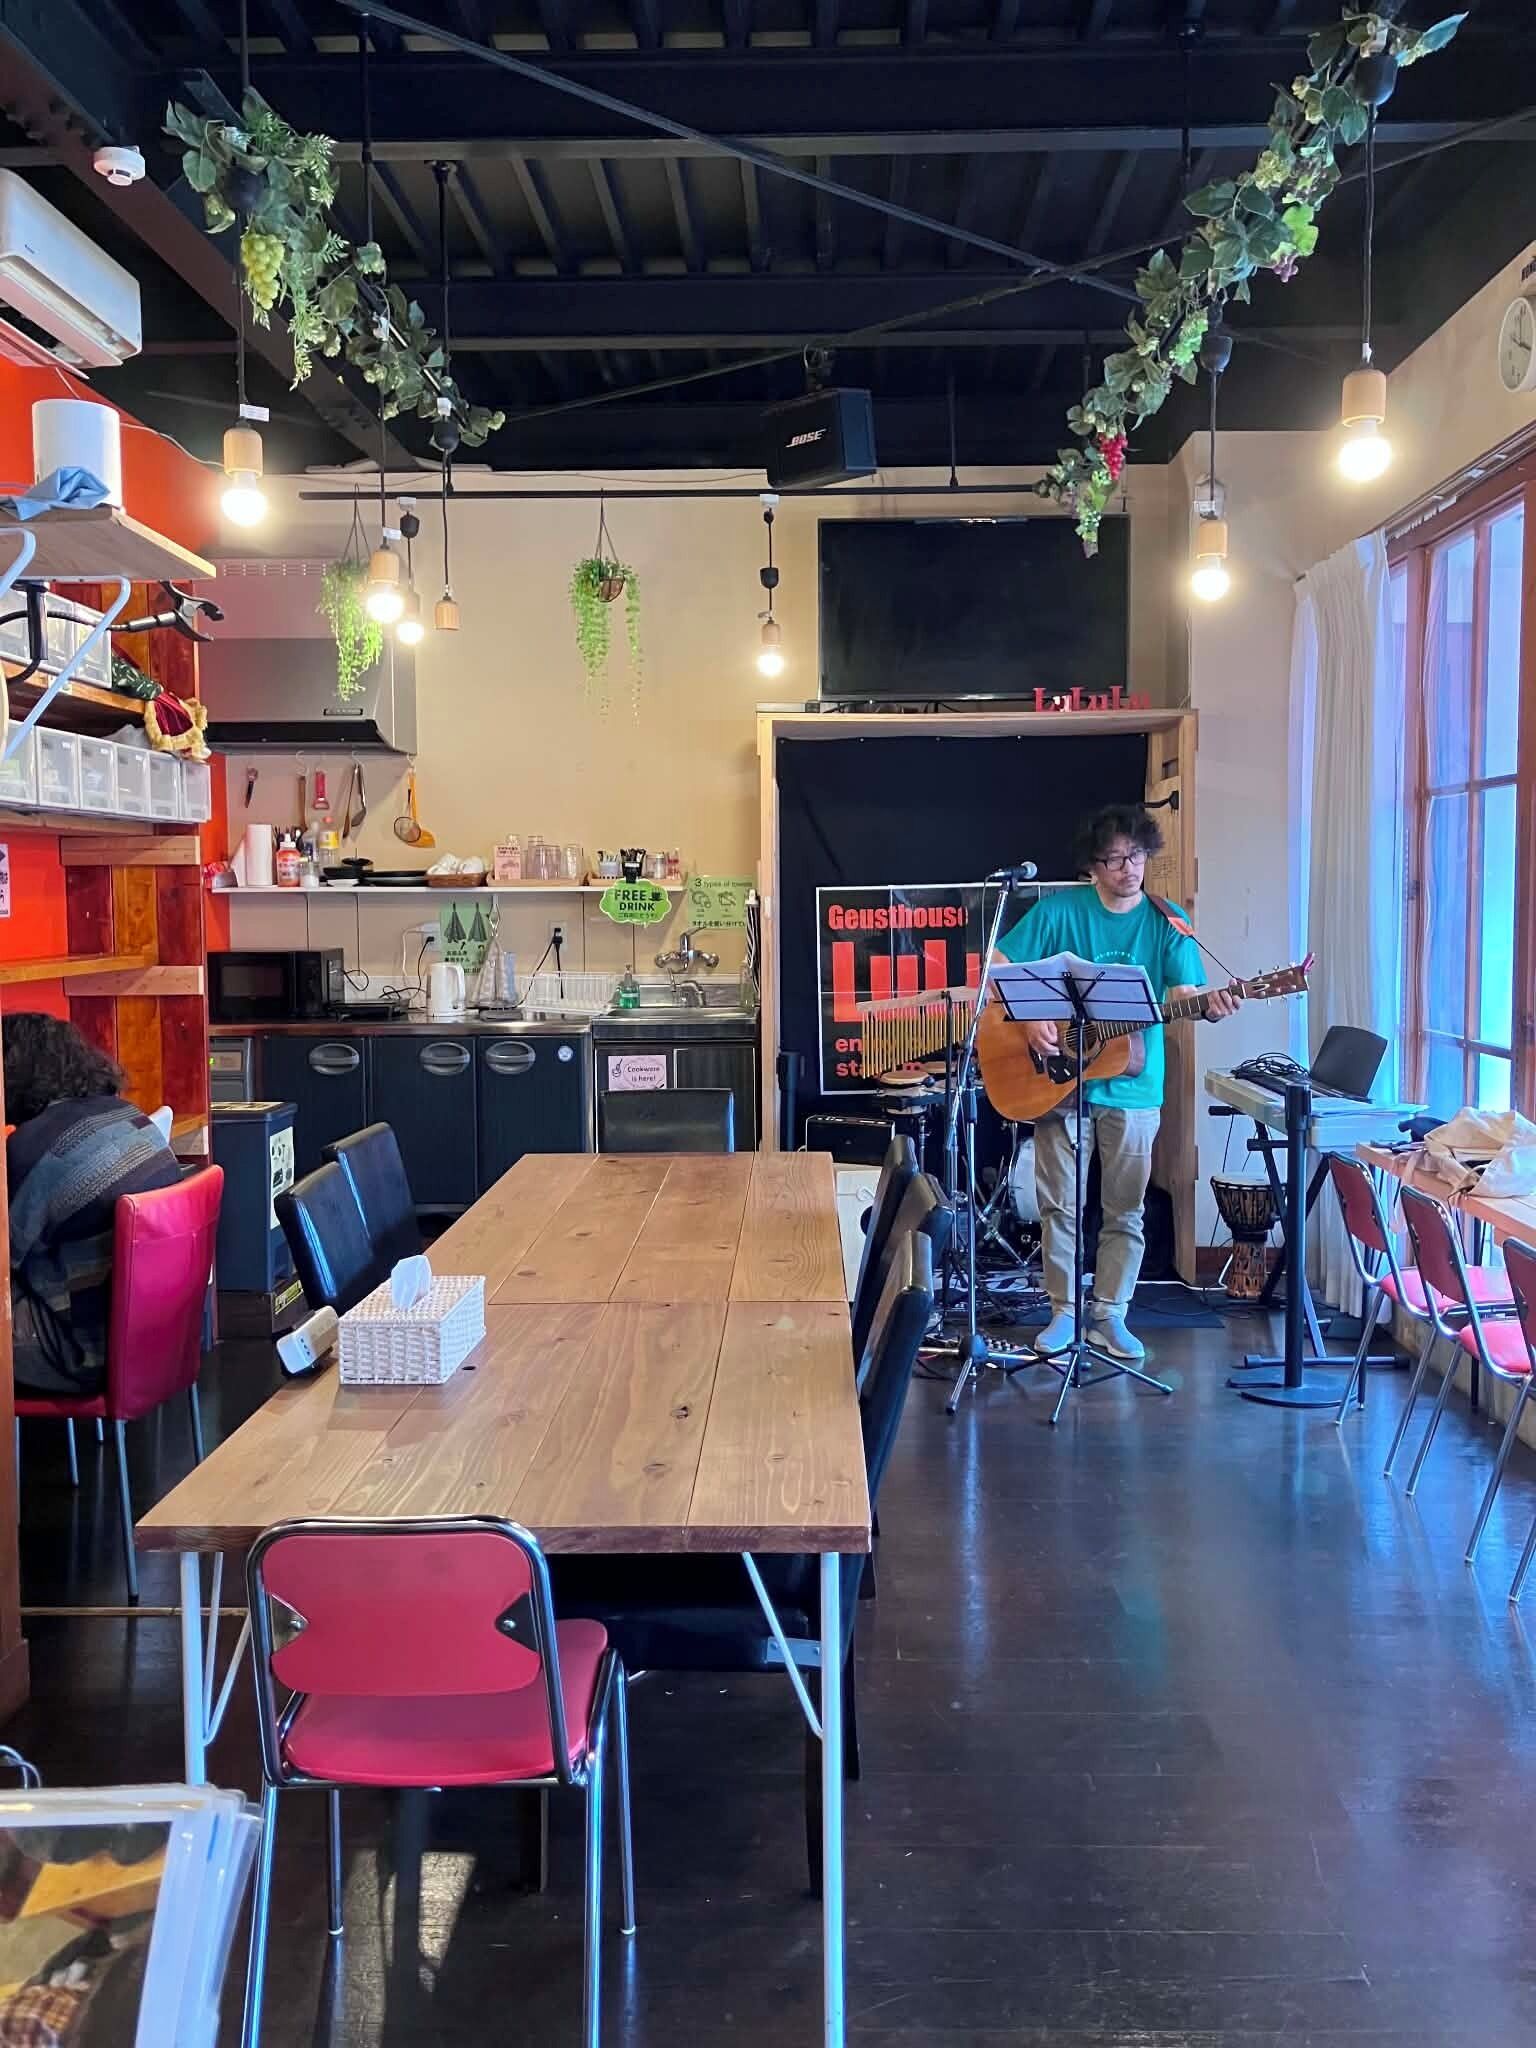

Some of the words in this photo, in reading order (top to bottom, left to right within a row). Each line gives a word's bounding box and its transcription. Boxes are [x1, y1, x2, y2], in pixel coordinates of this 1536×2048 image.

[786, 429, 826, 448] BOSE
[695, 878, 702, 887] 3
[614, 889, 646, 901] FREE
[619, 902, 656, 911] DRINK
